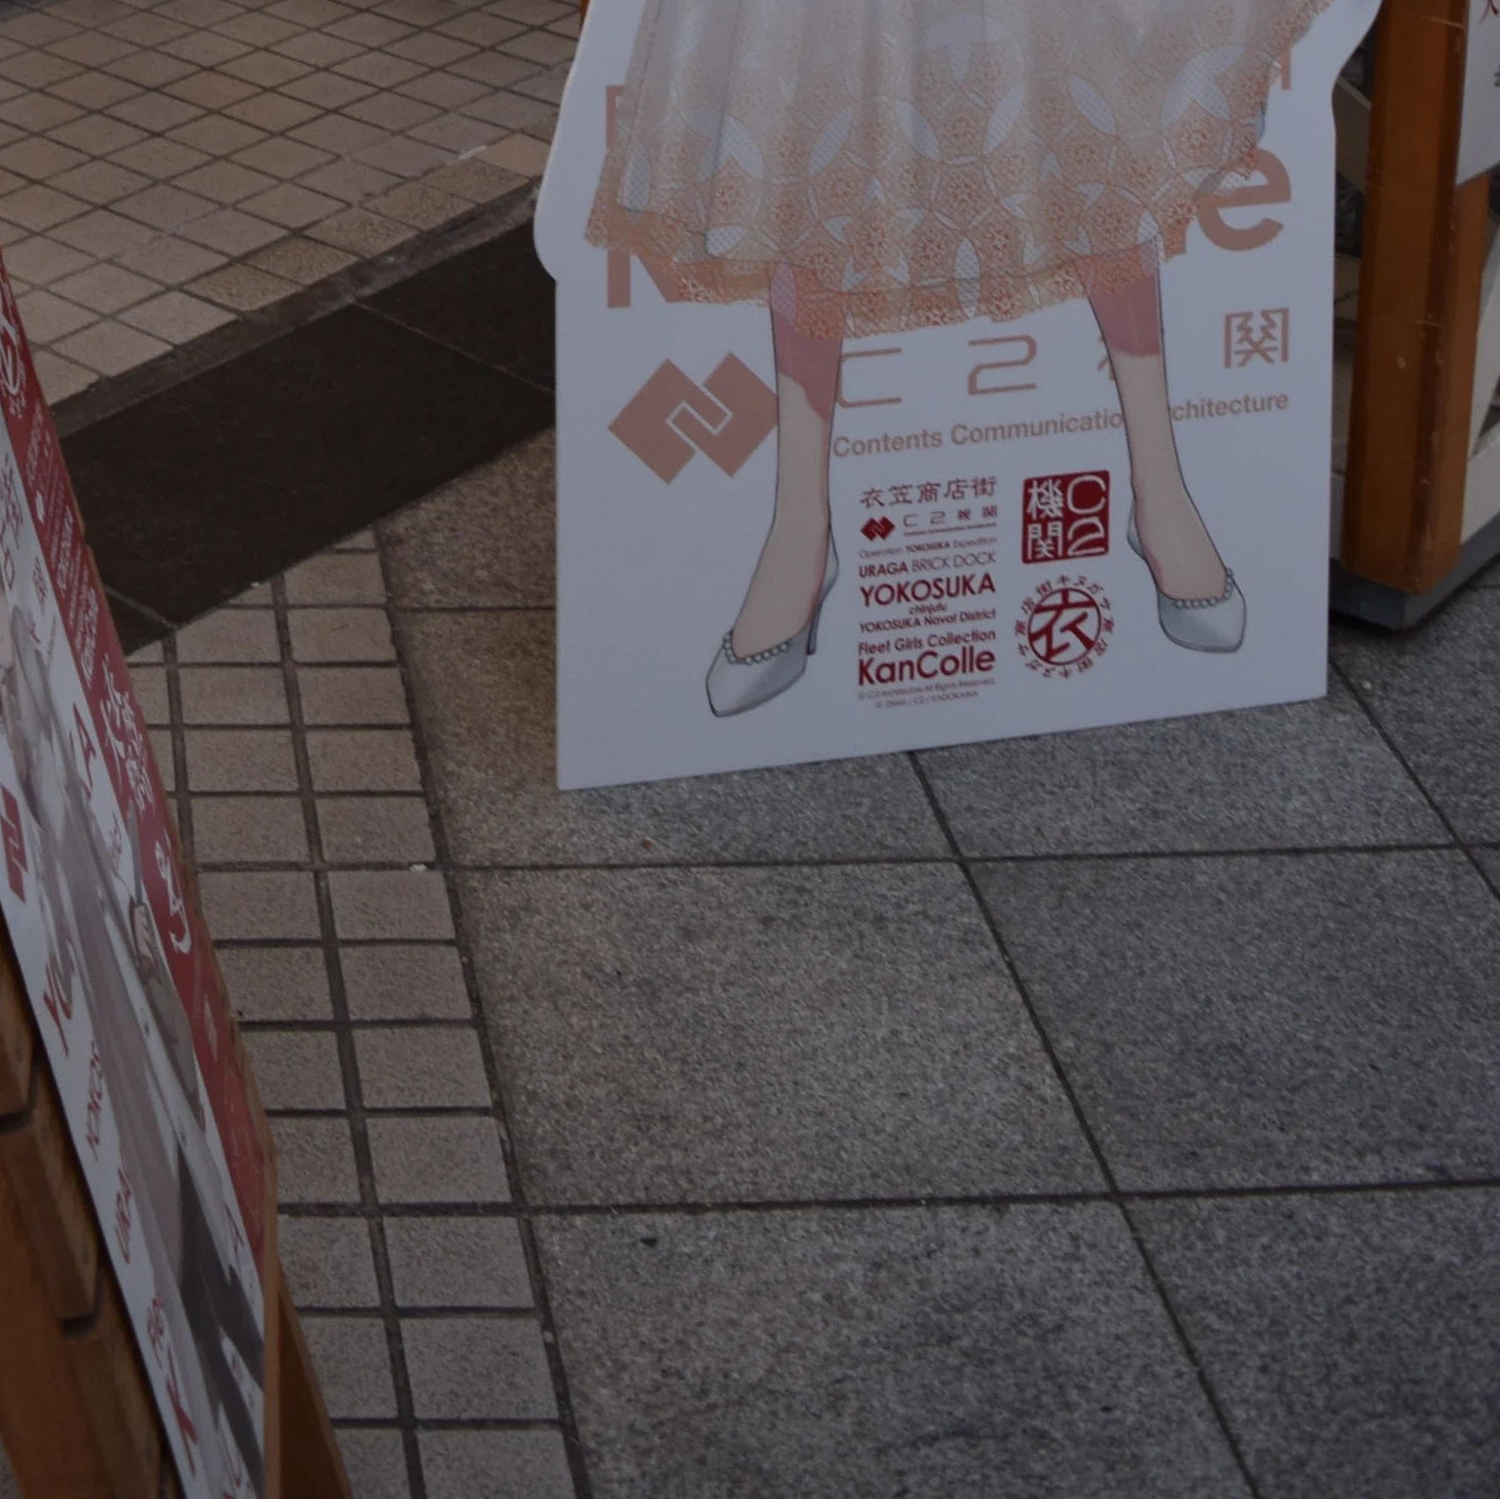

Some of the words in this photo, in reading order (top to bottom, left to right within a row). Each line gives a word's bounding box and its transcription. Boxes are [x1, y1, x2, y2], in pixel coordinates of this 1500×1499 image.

[832, 424, 944, 459] Contents
[950, 406, 1122, 446] Communicatio
[1169, 391, 1290, 423] chitecture
[860, 476, 997, 508] 衣笠商店街
[906, 540, 951, 553] YOKOSUKA
[859, 561, 909, 578] URAGA
[911, 556, 950, 572] BRICK
[953, 551, 997, 568] DOCK
[860, 572, 996, 607] YOKOSUKA
[859, 617, 921, 633] YOKOSUKA
[924, 613, 957, 627] Naval
[959, 608, 997, 624] District
[859, 641, 890, 655] Fleet
[894, 636, 923, 651] Girls
[927, 629, 997, 648] Collection
[858, 646, 996, 686] KanColle
